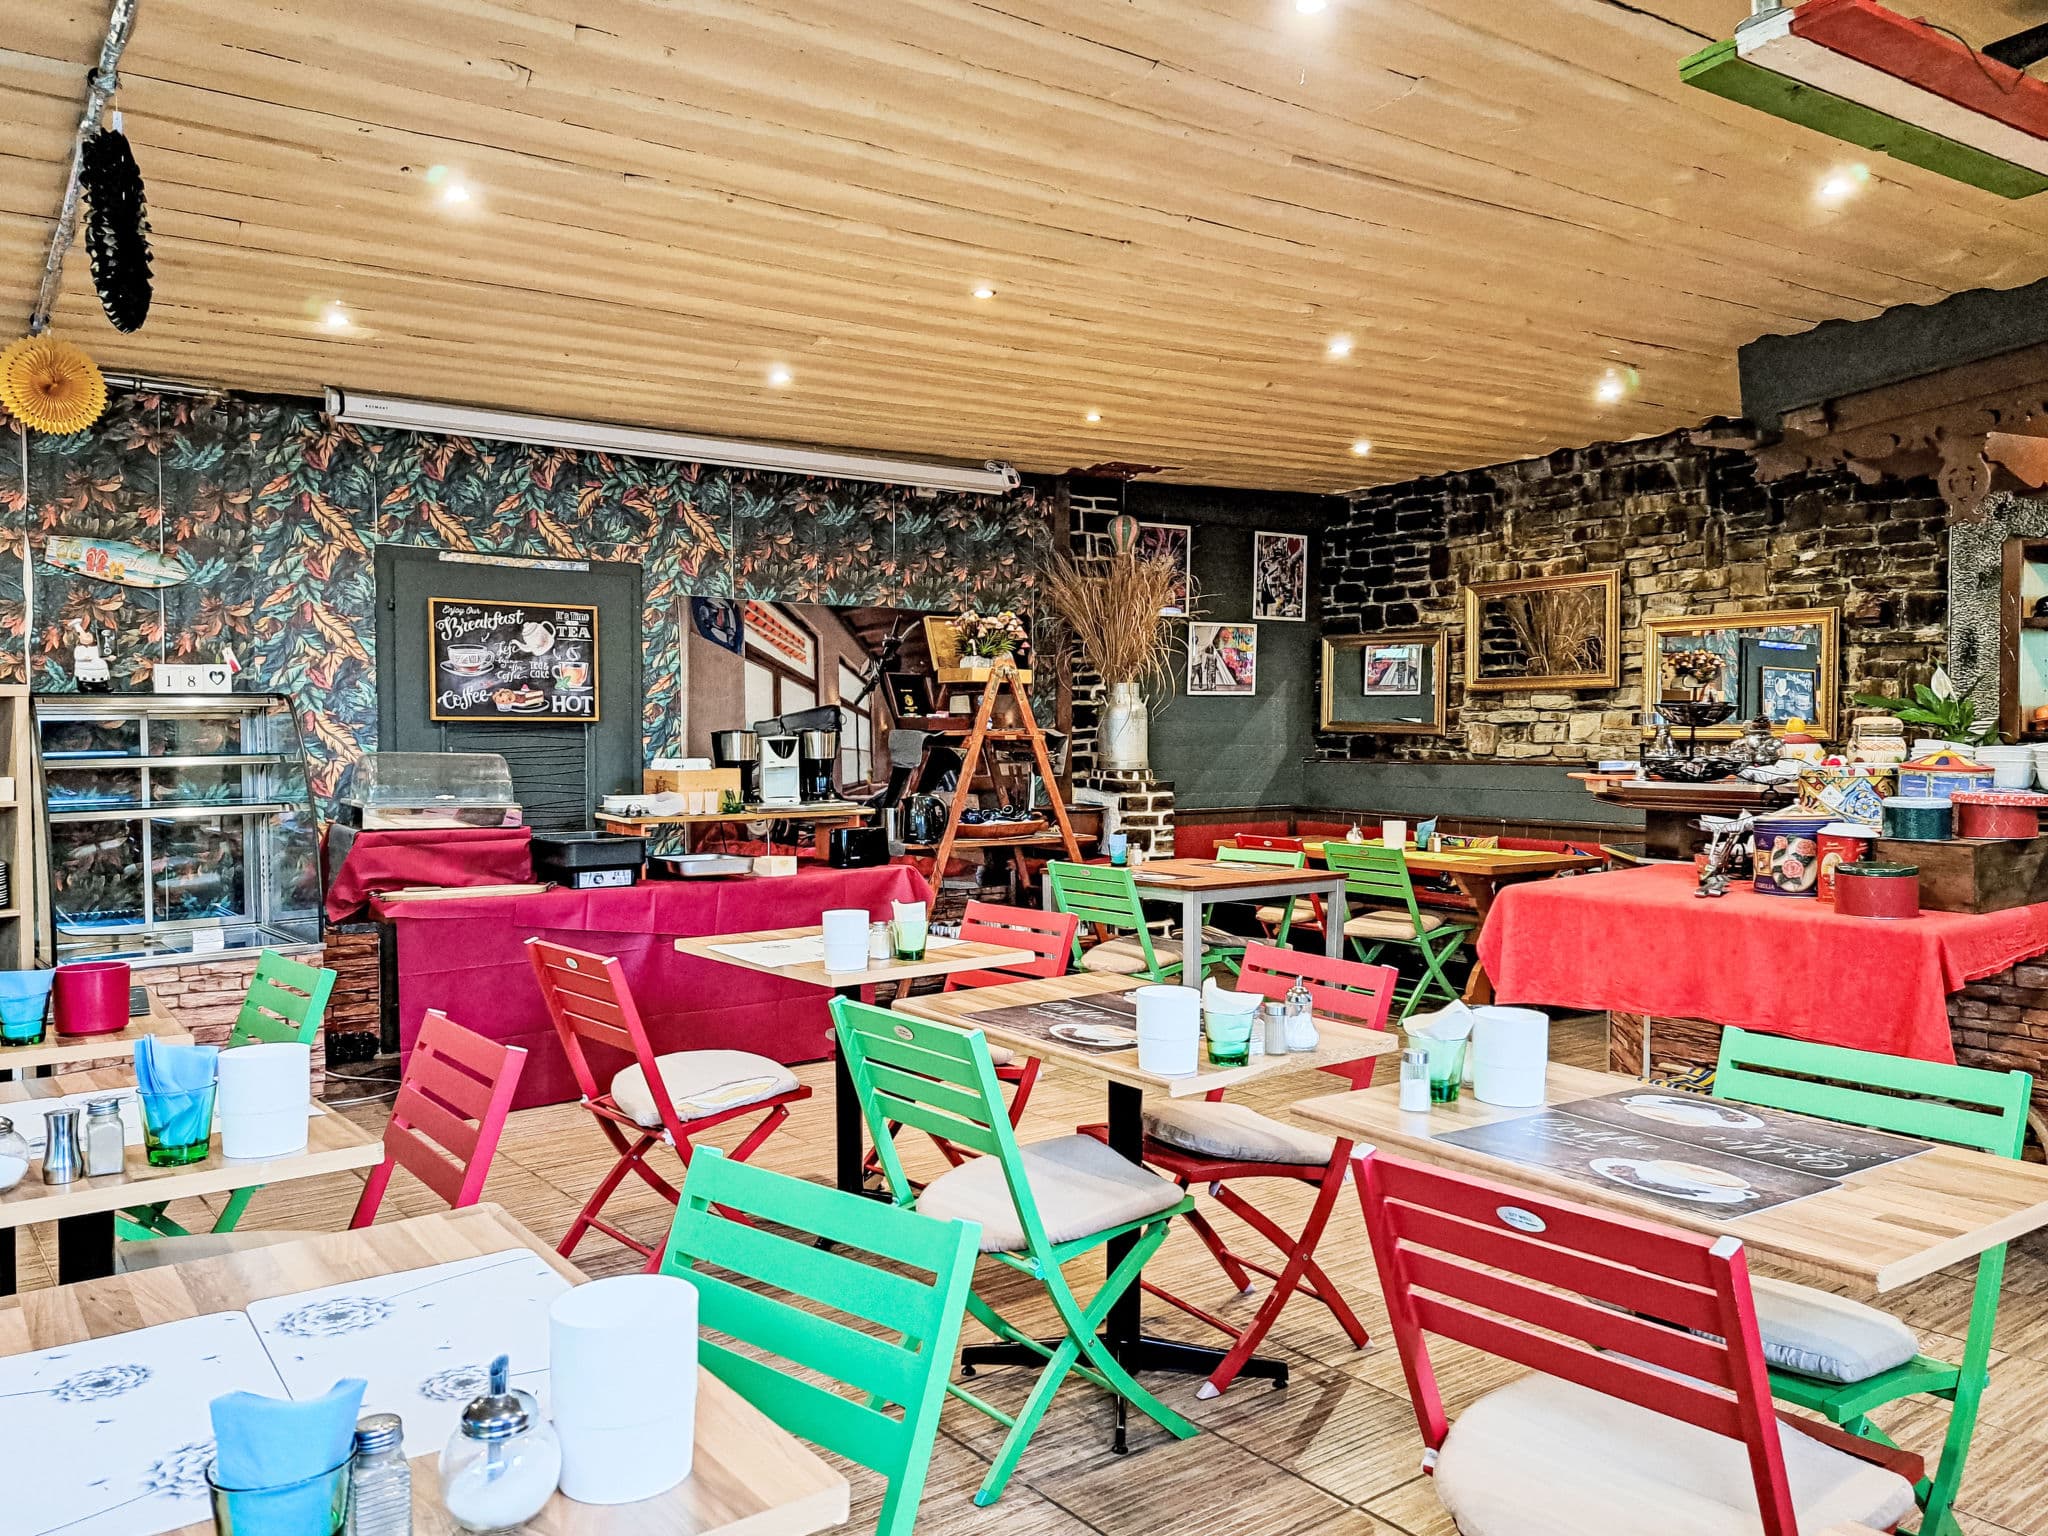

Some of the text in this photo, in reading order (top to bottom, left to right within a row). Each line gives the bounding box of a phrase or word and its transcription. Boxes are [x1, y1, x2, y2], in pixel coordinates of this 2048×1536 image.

[435, 609, 525, 641] Breakfast
[555, 626, 591, 638] TEA
[437, 685, 493, 710] Coffee
[551, 695, 594, 713] HOT
[1529, 1118, 1660, 1150] Coffee
